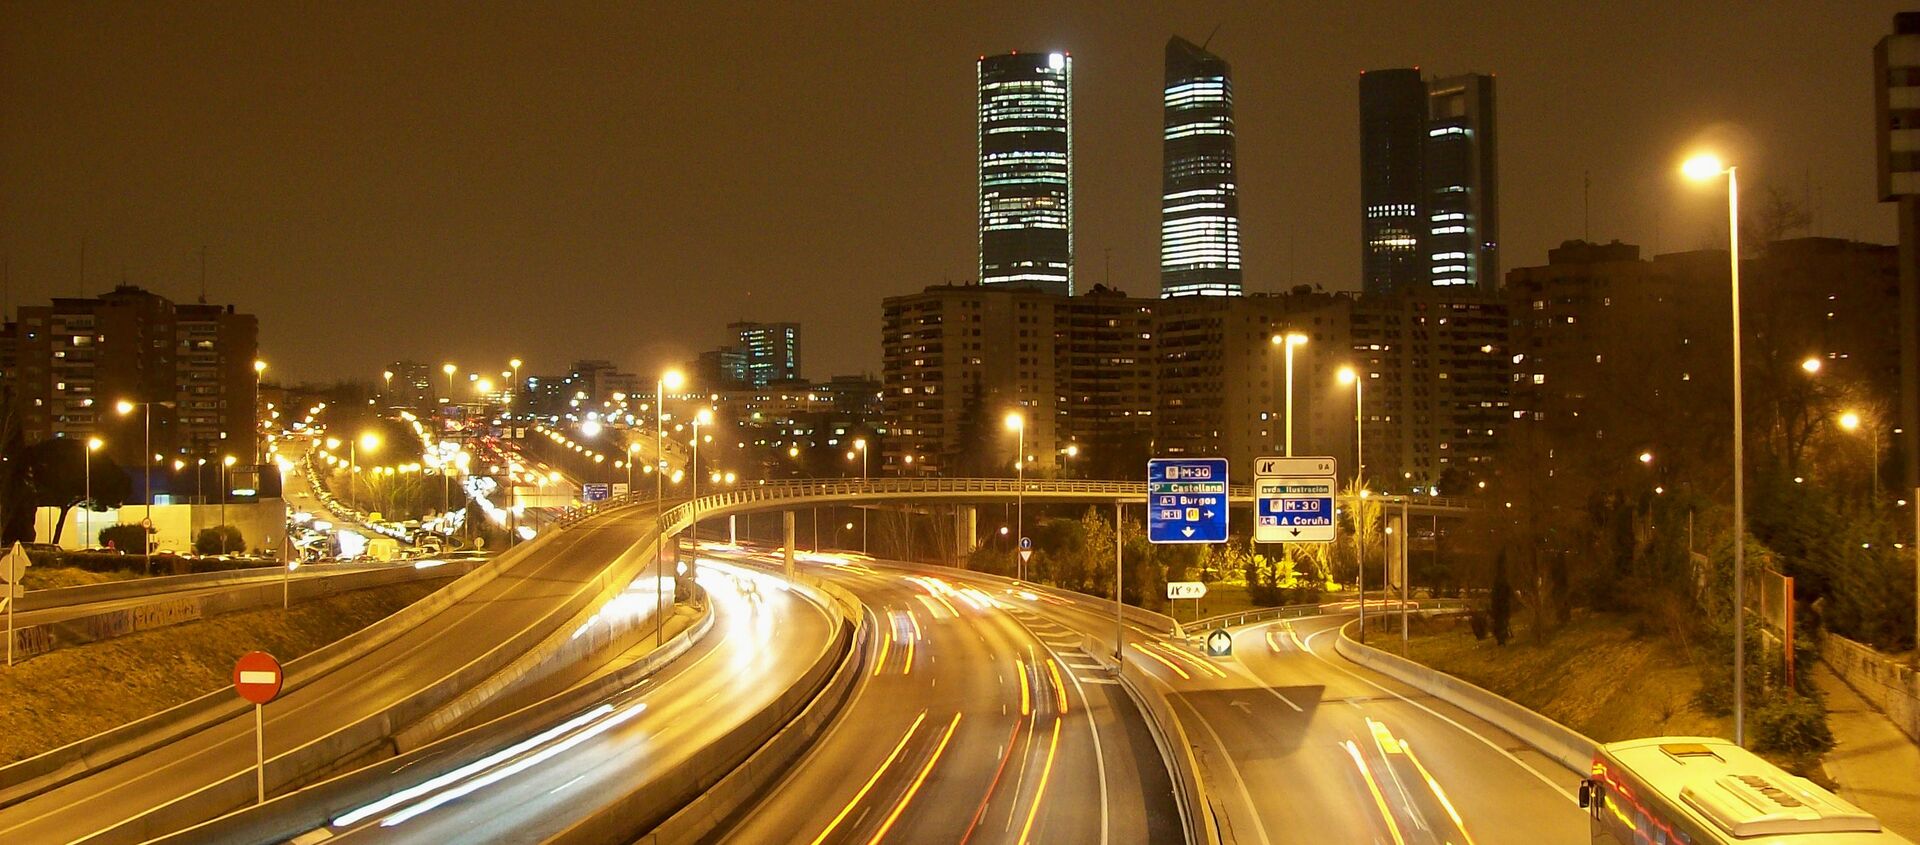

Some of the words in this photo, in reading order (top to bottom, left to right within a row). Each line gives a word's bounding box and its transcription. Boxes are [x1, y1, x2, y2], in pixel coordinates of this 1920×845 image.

[1181, 468, 1210, 477] M-30
[1171, 484, 1222, 492] Castellana
[1180, 496, 1217, 506] Burgos
[1286, 501, 1318, 510] M-30
[1281, 517, 1288, 525] A
[1293, 516, 1330, 525] Coruña
